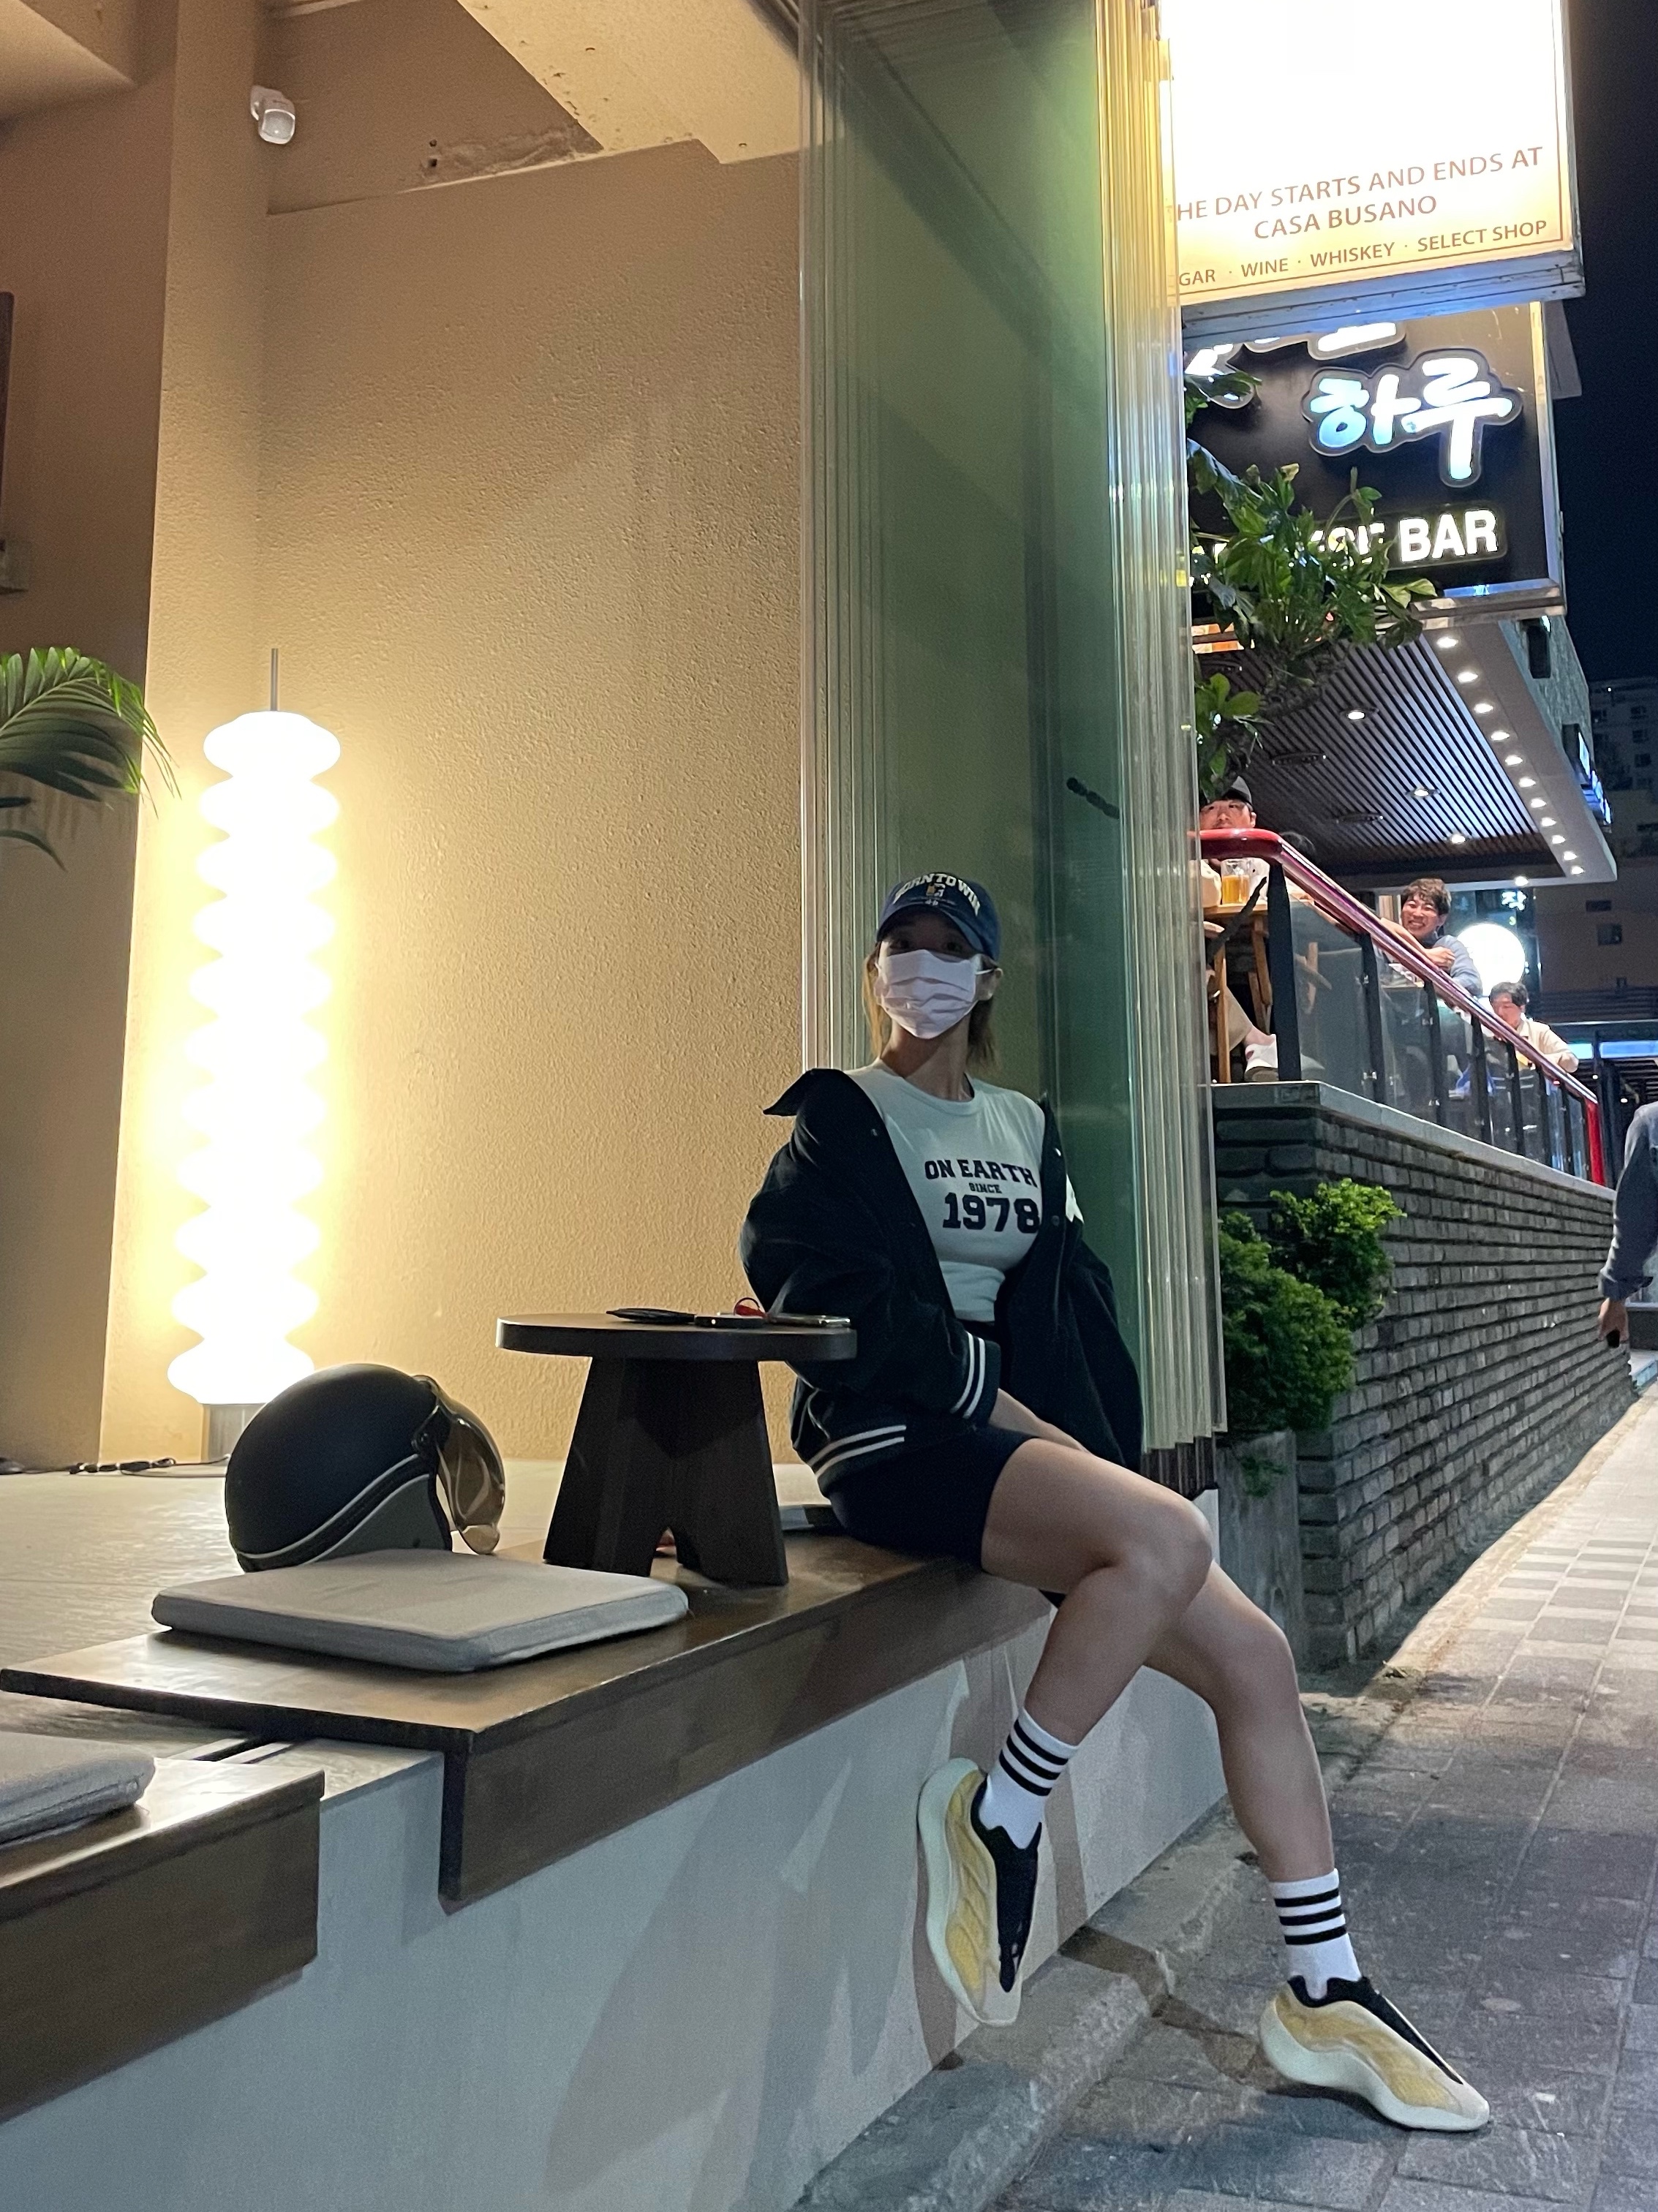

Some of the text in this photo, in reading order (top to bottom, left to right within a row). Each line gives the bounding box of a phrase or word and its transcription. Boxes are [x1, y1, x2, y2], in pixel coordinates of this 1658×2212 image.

[1177, 146, 1542, 221] HE DAY STARTS AND ENDS AT
[1254, 195, 1437, 239] CASA BUSANO
[1178, 220, 1547, 287] GAR WINE WHISKEY SELECT SHOP
[1309, 357, 1513, 480] 하루
[1398, 508, 1498, 563] BAR
[924, 1159, 1039, 1188] ON EARTH
[968, 1182, 1002, 1194] SINCE
[942, 1192, 1041, 1234] 1978
